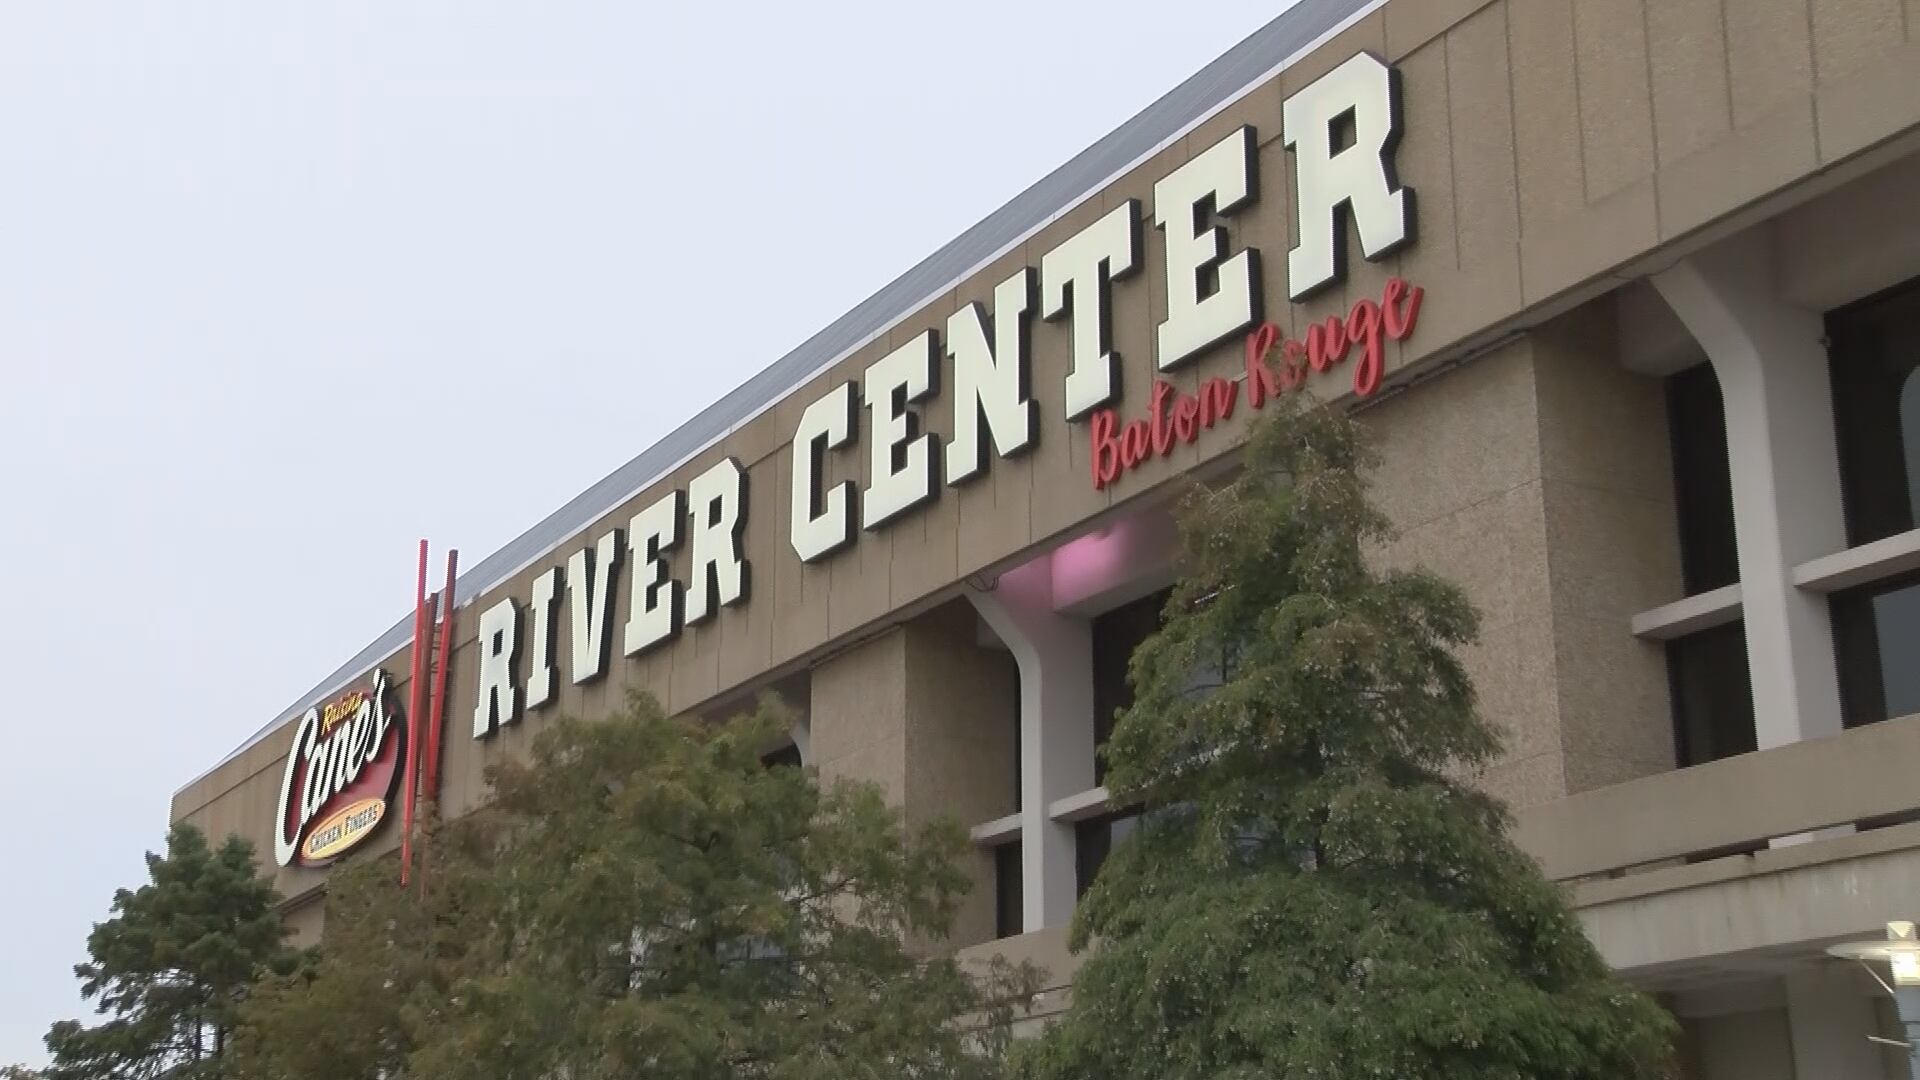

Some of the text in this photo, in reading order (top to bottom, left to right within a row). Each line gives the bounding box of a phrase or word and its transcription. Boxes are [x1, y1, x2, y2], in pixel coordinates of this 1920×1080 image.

[473, 50, 1412, 740] RIVER CENTER
[1090, 277, 1424, 489] Baton Rouge
[275, 668, 391, 866] Cane's
[309, 804, 377, 854] CHICKEN FINGERS
